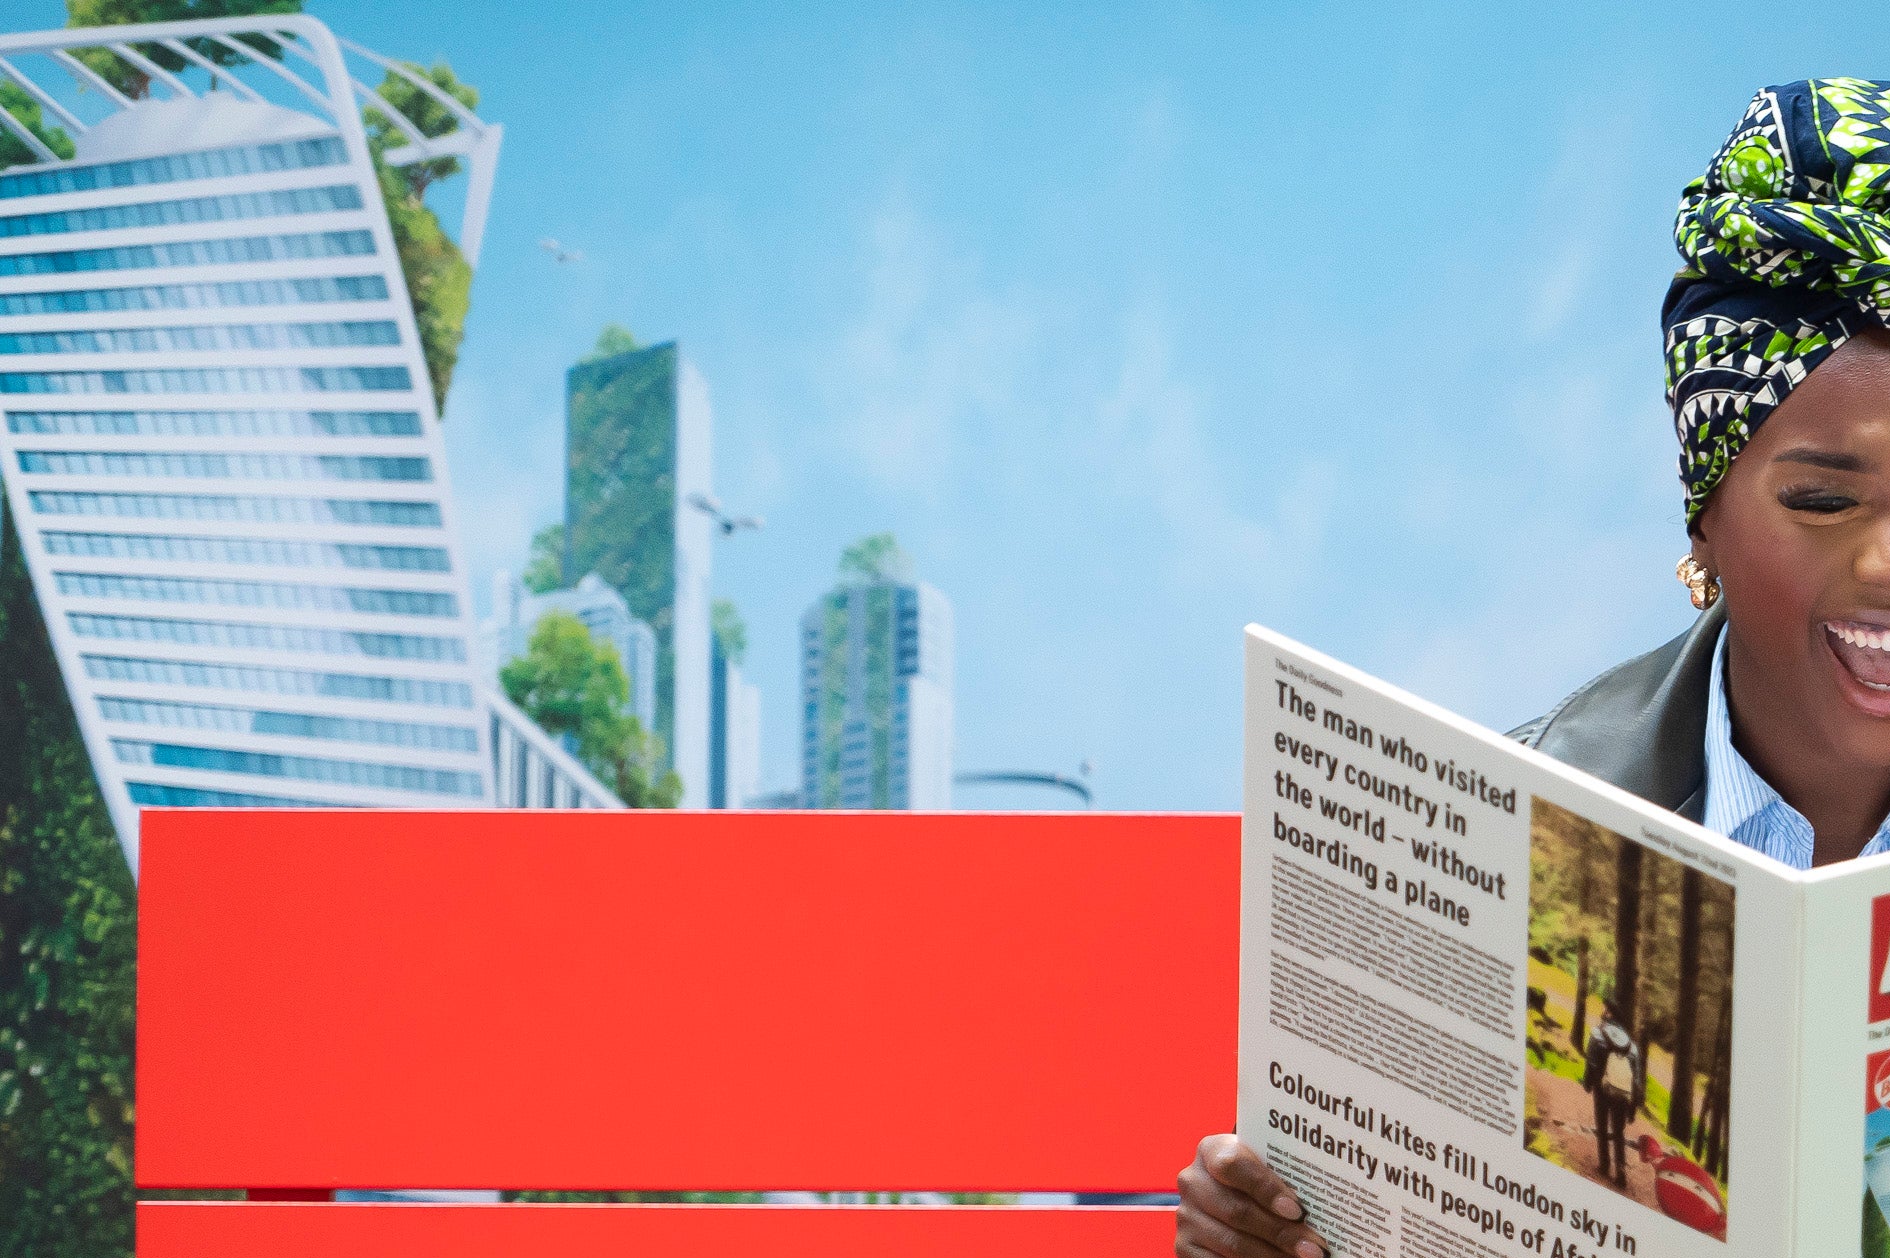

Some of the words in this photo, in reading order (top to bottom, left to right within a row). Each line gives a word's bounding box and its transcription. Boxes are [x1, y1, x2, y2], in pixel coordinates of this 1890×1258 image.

[1275, 657, 1287, 672] The
[1274, 731, 1338, 781] every
[1344, 763, 1437, 827] country
[1445, 802, 1466, 836] in
[1275, 679, 1316, 722] The
[1323, 708, 1372, 748] man
[1379, 734, 1427, 773] who
[1434, 759, 1515, 814] visited
[1273, 811, 1377, 890] boarding
[1384, 870, 1397, 893] a
[1404, 880, 1469, 926] plane
[1274, 769, 1312, 809] the
[1319, 795, 1384, 843] world
[1410, 837, 1505, 900] without
[1868, 1030, 1883, 1039] The
[1268, 1108, 1377, 1180] solidarity
[1383, 1162, 1434, 1203] with
[1440, 1189, 1514, 1240] people
[1520, 1228, 1544, 1253] of
[1269, 1061, 1373, 1132] Colourful
[1380, 1112, 1436, 1161] kites
[1442, 1143, 1475, 1180] fill
[1482, 1161, 1563, 1222] London
[1570, 1208, 1608, 1247] sky
[1615, 1224, 1635, 1256] in
